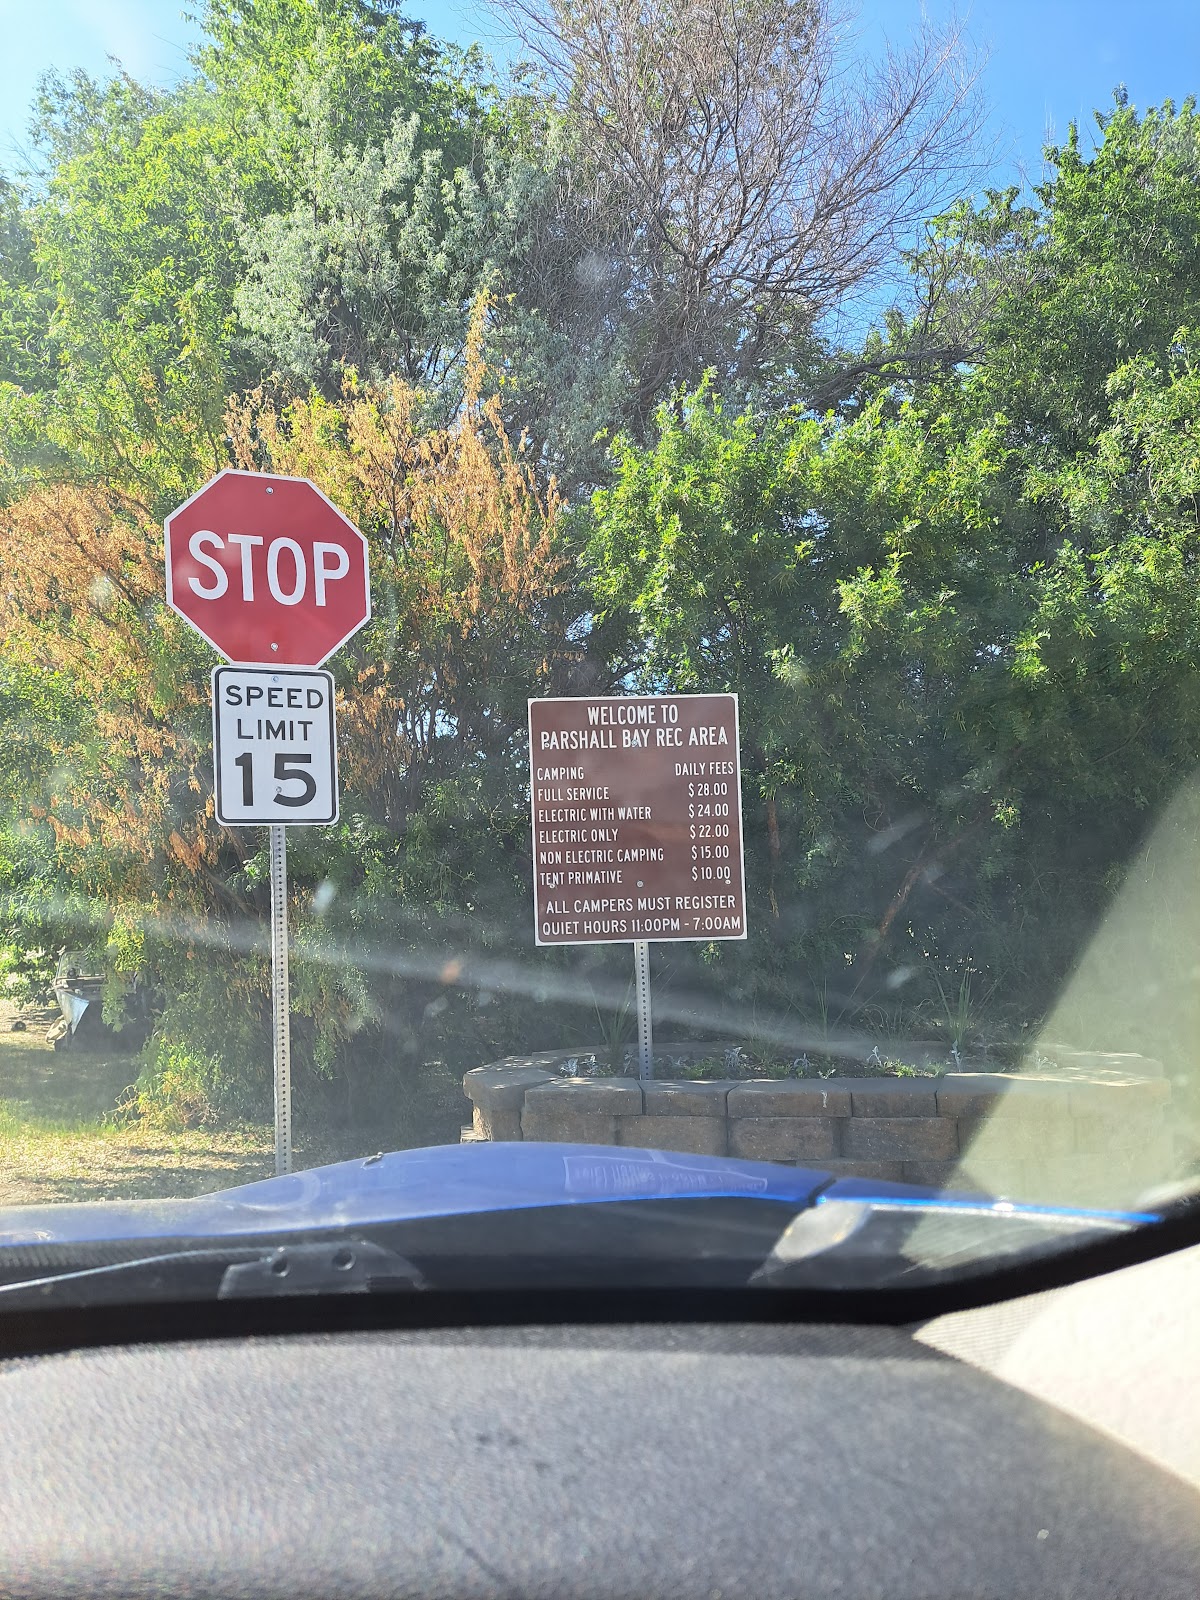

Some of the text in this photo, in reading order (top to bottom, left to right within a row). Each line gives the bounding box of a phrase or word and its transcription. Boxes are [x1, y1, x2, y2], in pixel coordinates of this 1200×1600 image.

[187, 530, 350, 607] STOP
[225, 684, 324, 709] SPEED
[588, 704, 678, 726] WELCOME TO
[237, 718, 313, 741] LIMIT
[541, 727, 728, 750] PARSHALL BAY REC AREA
[537, 767, 584, 781] CAMPING
[675, 762, 734, 776] DAILY FEES
[234, 752, 317, 807] 15
[538, 787, 609, 801] FULL SERVICE
[539, 806, 651, 823] ELECTRIC WITH WATER
[539, 829, 618, 843] ELECTRIC ONLY
[540, 848, 664, 865] NON ELECTRIC CAMPING
[540, 871, 623, 886] TENT PRIMATIVE
[546, 895, 735, 914] ALL CAMPERS MUST REGISTER
[543, 921, 579, 936] QUIET
[584, 920, 627, 934] HOURS
[631, 918, 680, 932] 11:00PM
[693, 917, 741, 930] 7:00AM
